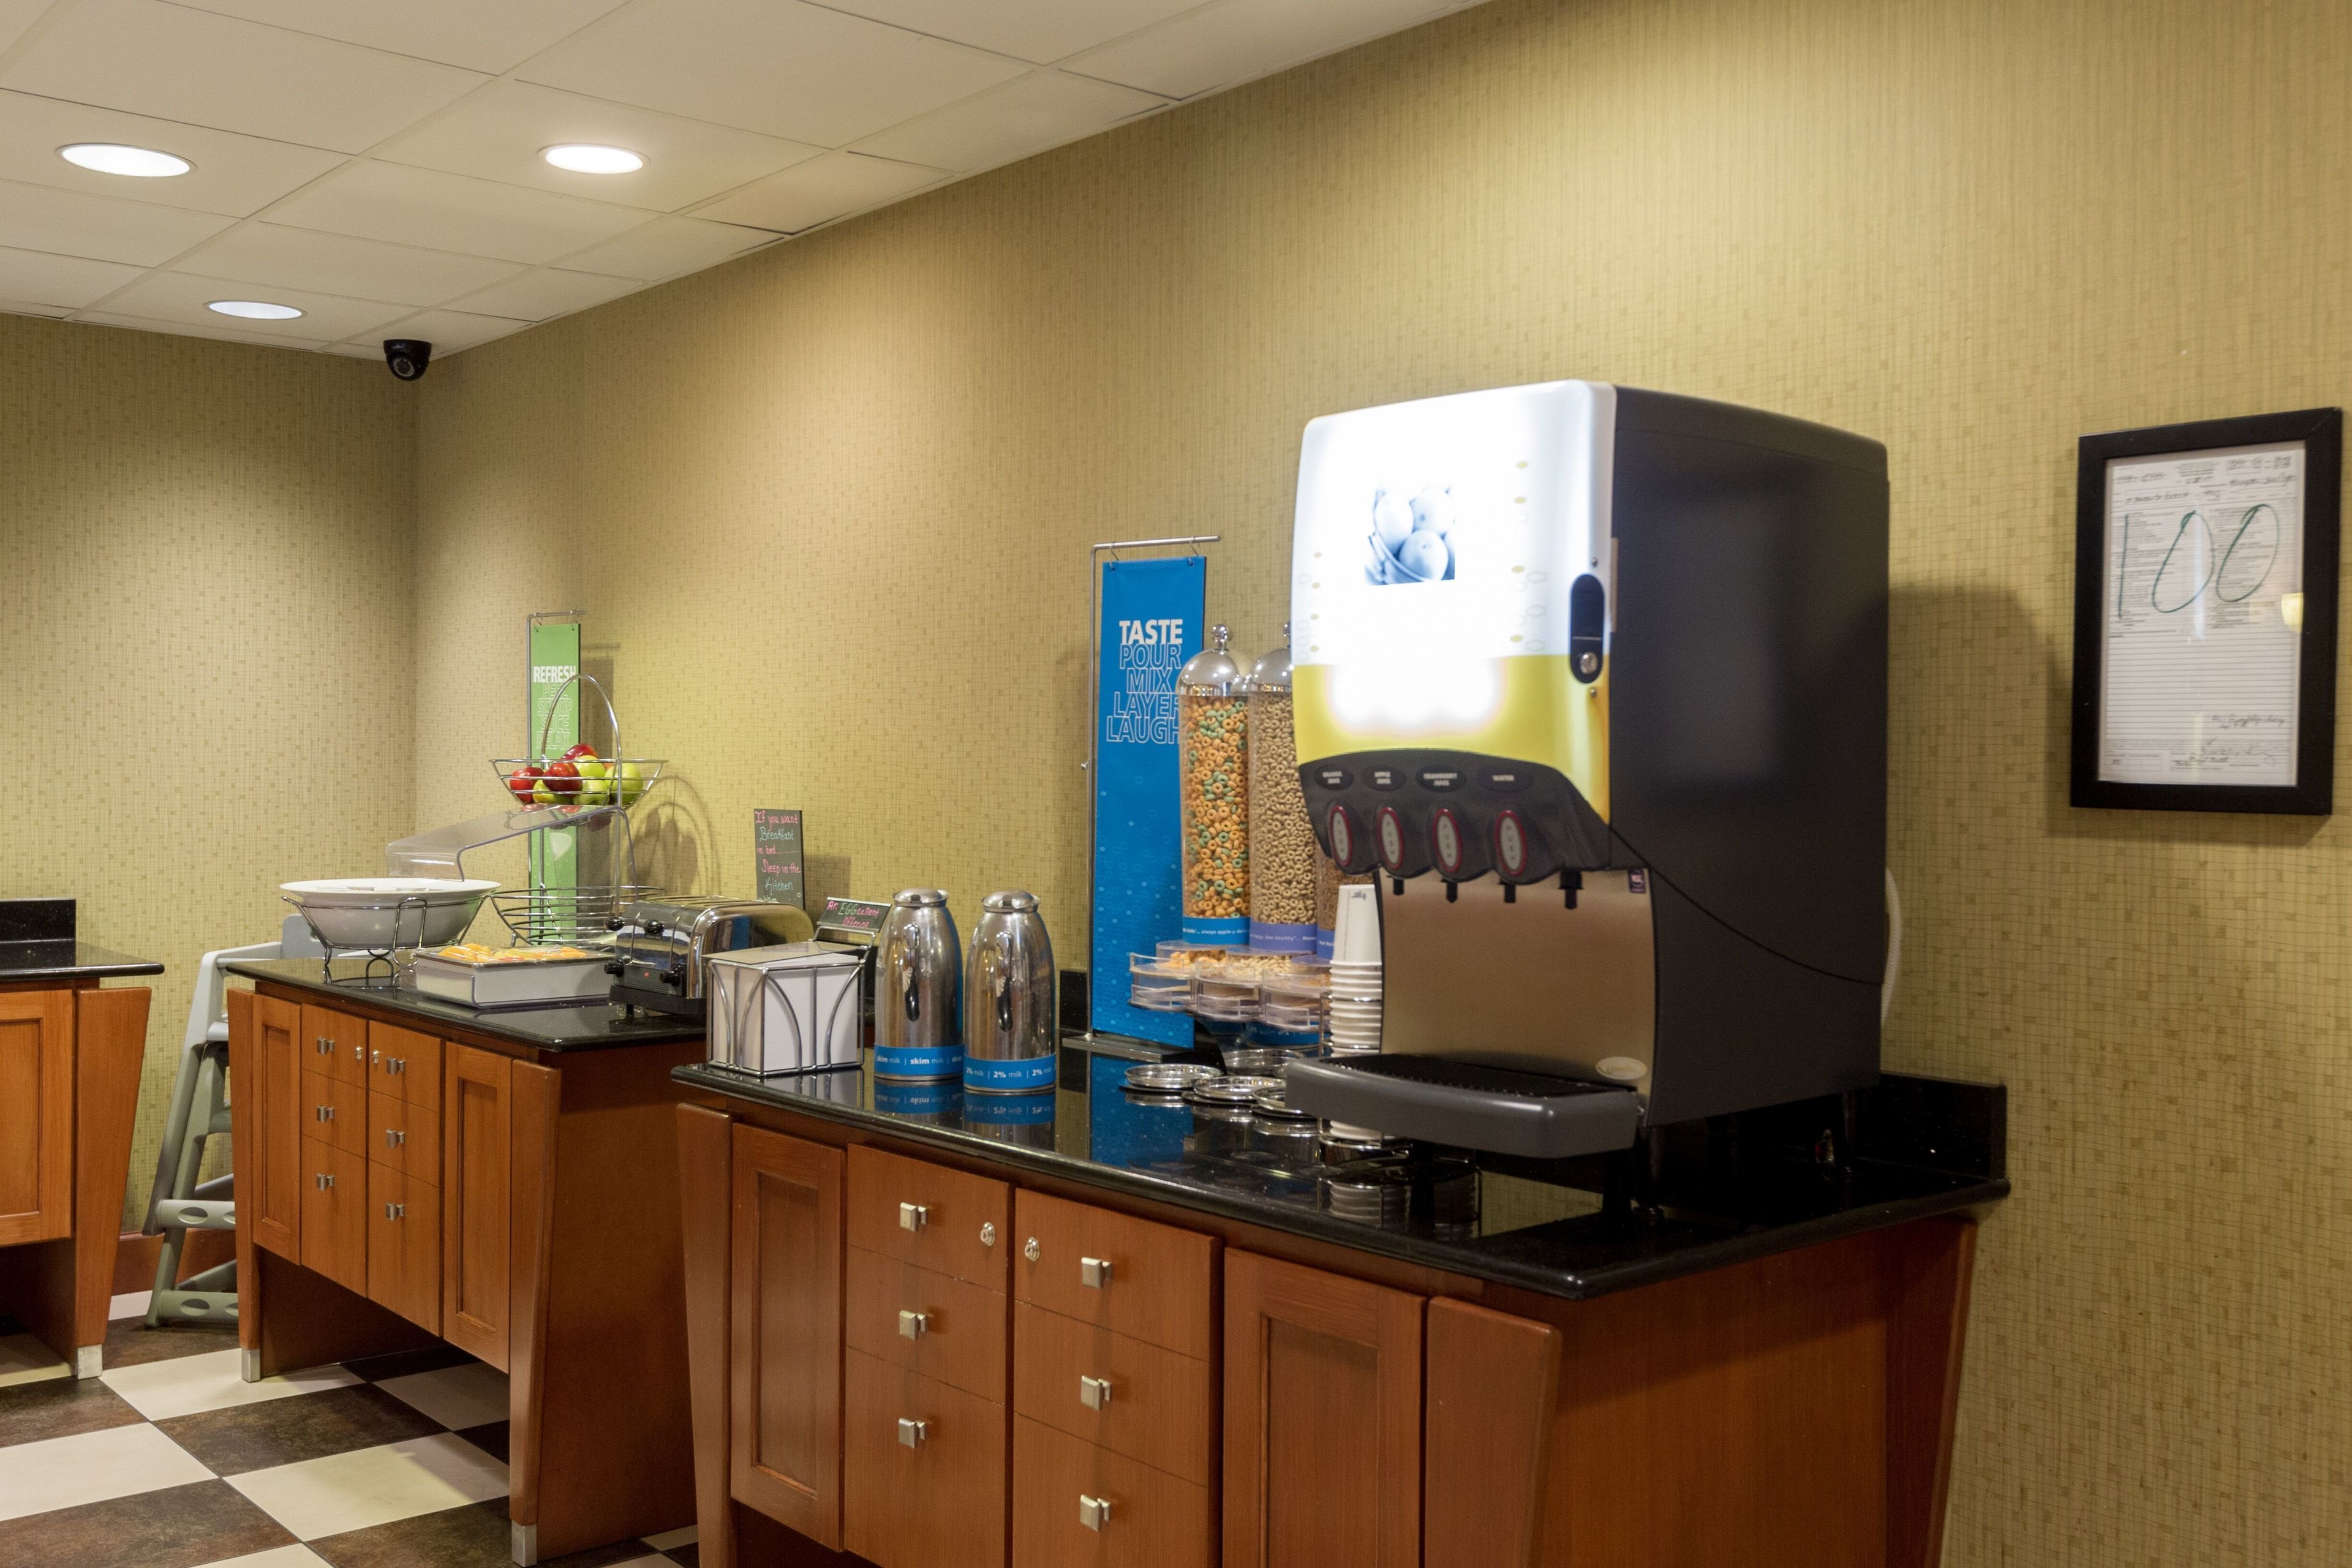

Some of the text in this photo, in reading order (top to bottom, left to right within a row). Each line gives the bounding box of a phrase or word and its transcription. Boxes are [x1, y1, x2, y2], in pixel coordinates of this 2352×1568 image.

[2118, 503, 2280, 619] 100
[1119, 619, 1183, 644] TASTE
[1120, 643, 1182, 669] POUR
[1126, 668, 1173, 693] MIX
[755, 810, 798, 831] If you want
[760, 826, 794, 841] Breakfast
[762, 859, 801, 876] Sleep in the
[765, 876, 793, 895] Kitchen
[827, 900, 839, 911] An
